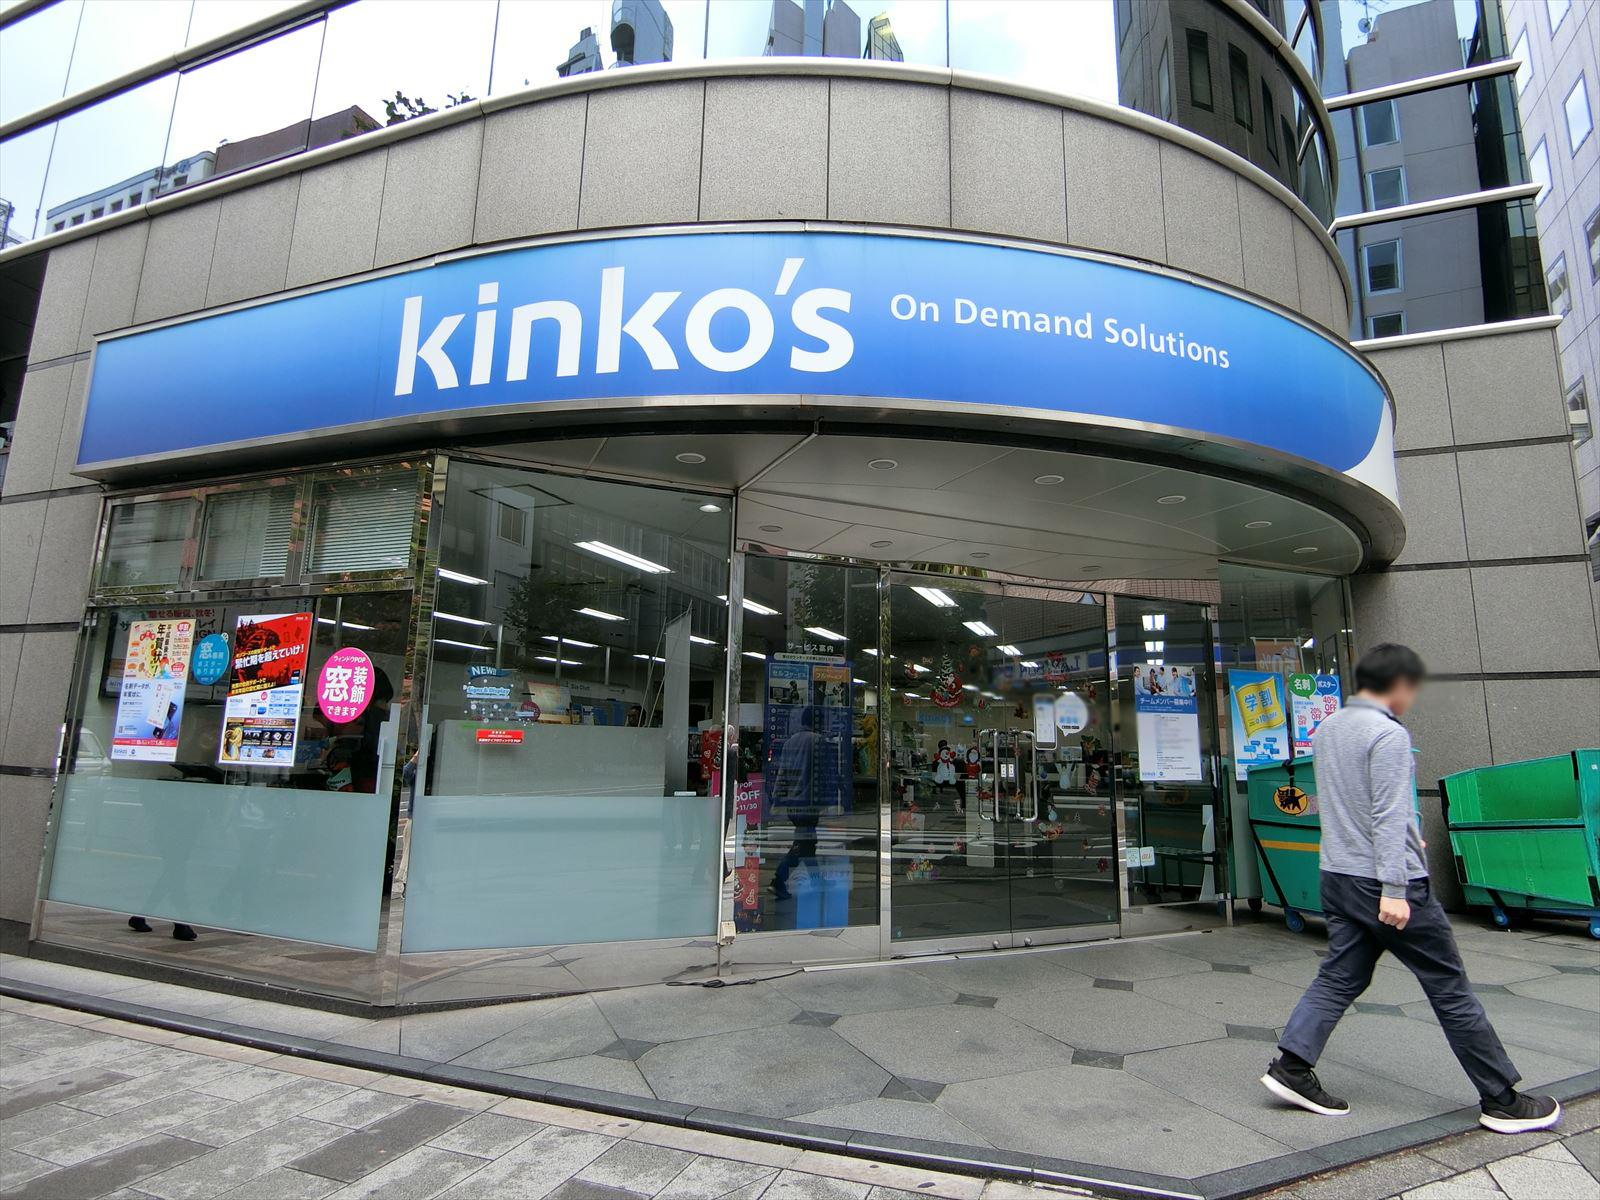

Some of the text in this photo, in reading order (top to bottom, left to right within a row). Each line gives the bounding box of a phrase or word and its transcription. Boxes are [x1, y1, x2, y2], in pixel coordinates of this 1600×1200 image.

[394, 258, 854, 396] kinko's
[890, 293, 1231, 369] On Demand Solutions
[322, 665, 369, 705] 窓 装飾
[1318, 680, 1336, 688] ポスター
[1323, 696, 1337, 704] 40%
[326, 705, 358, 717] できます
[1325, 704, 1337, 712] OFF
[740, 803, 758, 811] 11/30
